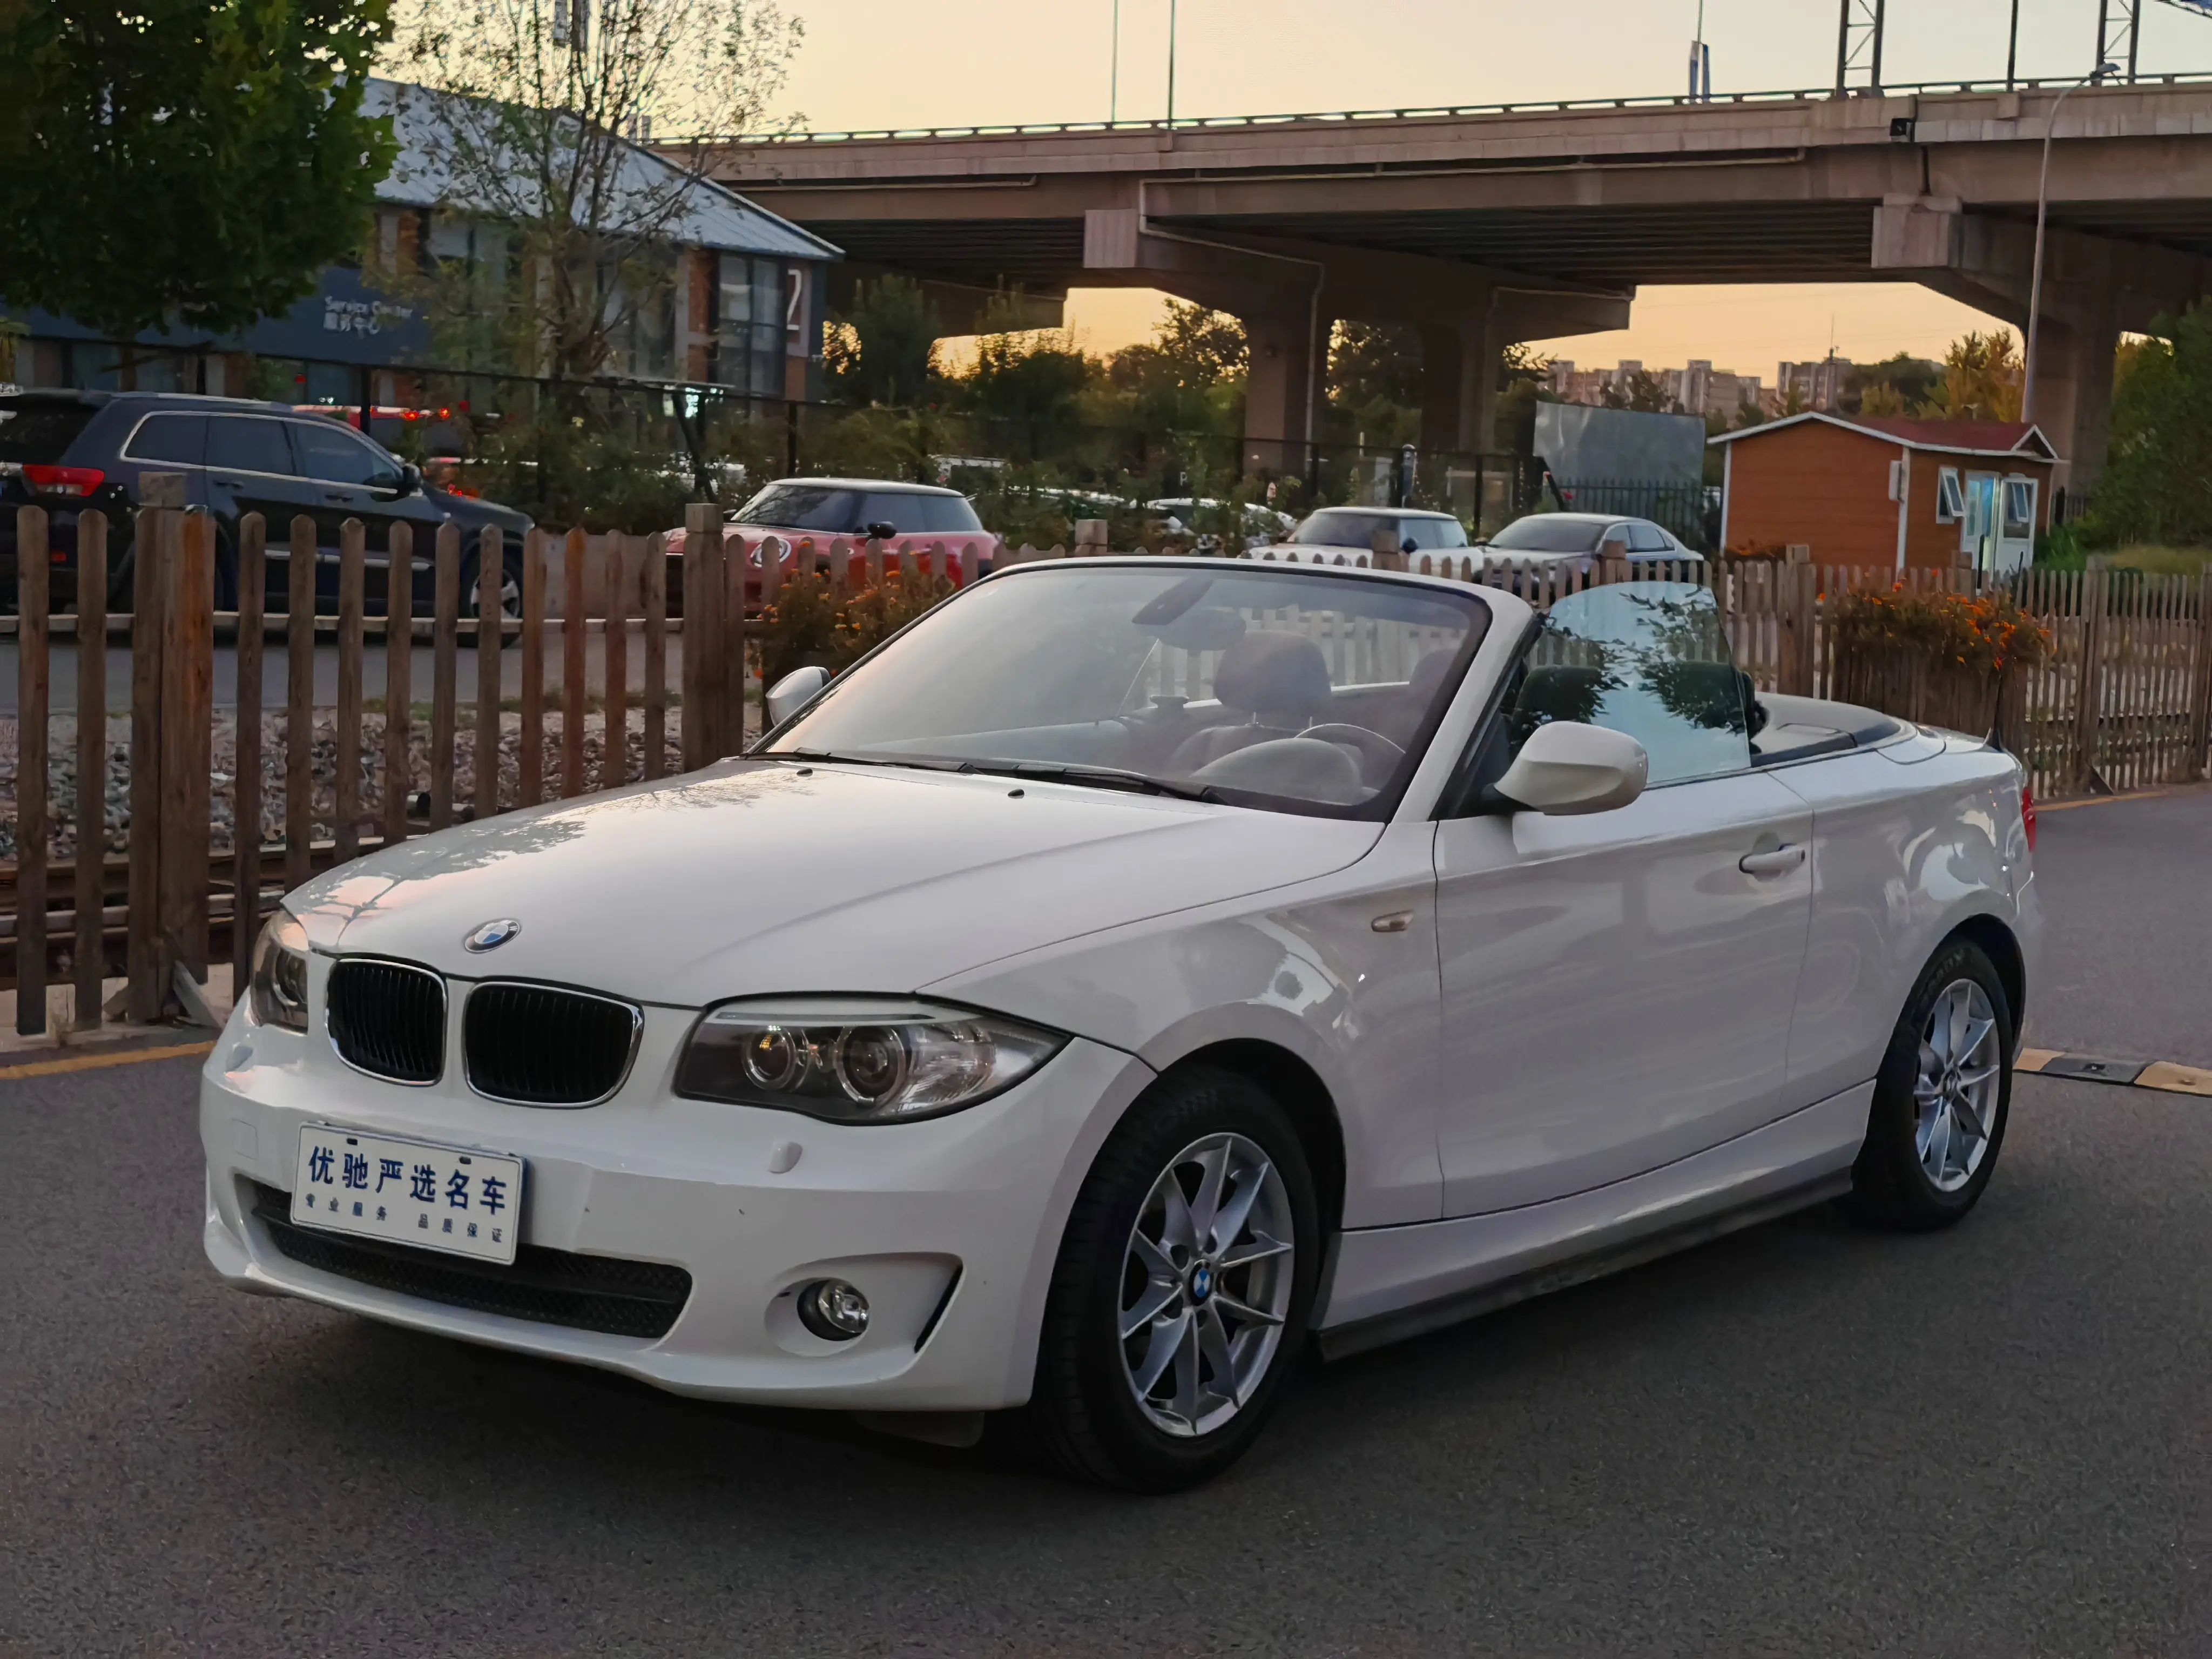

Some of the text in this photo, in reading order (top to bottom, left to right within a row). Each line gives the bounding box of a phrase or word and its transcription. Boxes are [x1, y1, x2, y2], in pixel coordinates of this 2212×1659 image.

[786, 269, 801, 330] 2
[308, 1145, 506, 1215] 优驰严选名车
